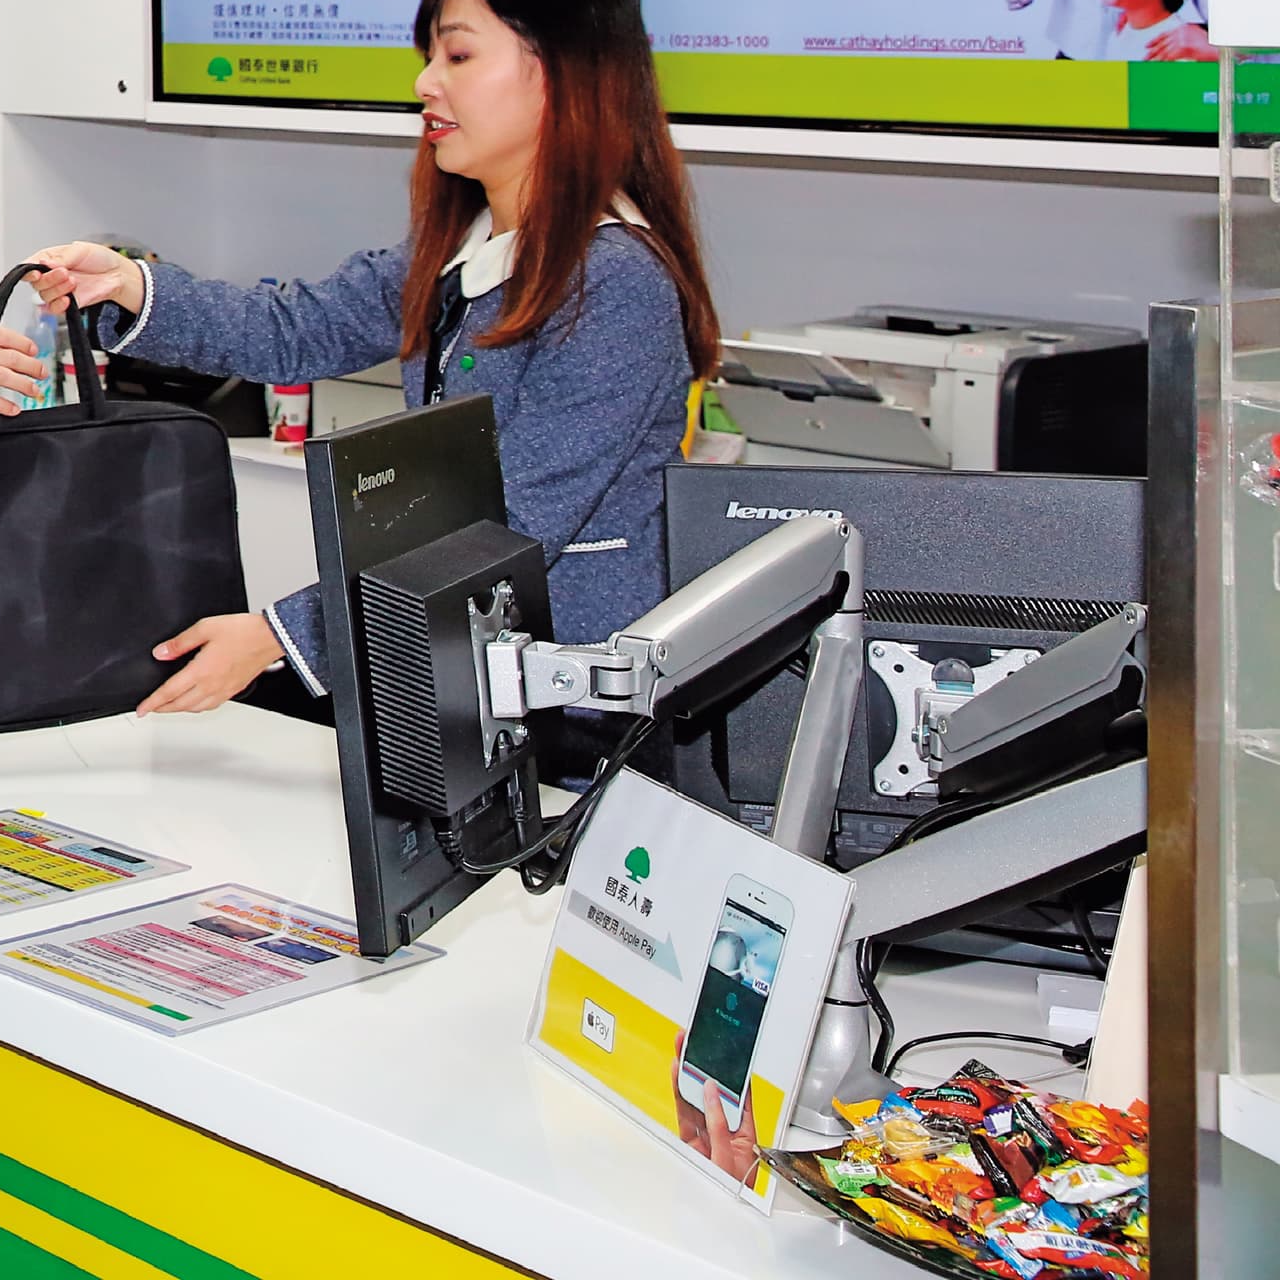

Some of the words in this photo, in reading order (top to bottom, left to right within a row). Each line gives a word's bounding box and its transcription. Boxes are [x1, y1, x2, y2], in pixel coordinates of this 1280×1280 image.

[803, 34, 1025, 53] www.cathayholdings.com/bank
[358, 468, 396, 494] lenovo
[604, 875, 654, 918] 國泰人壽
[618, 926, 641, 948] Apple
[641, 938, 657, 960] Pay
[754, 978, 770, 994] VISA
[594, 1015, 610, 1040] Pay
